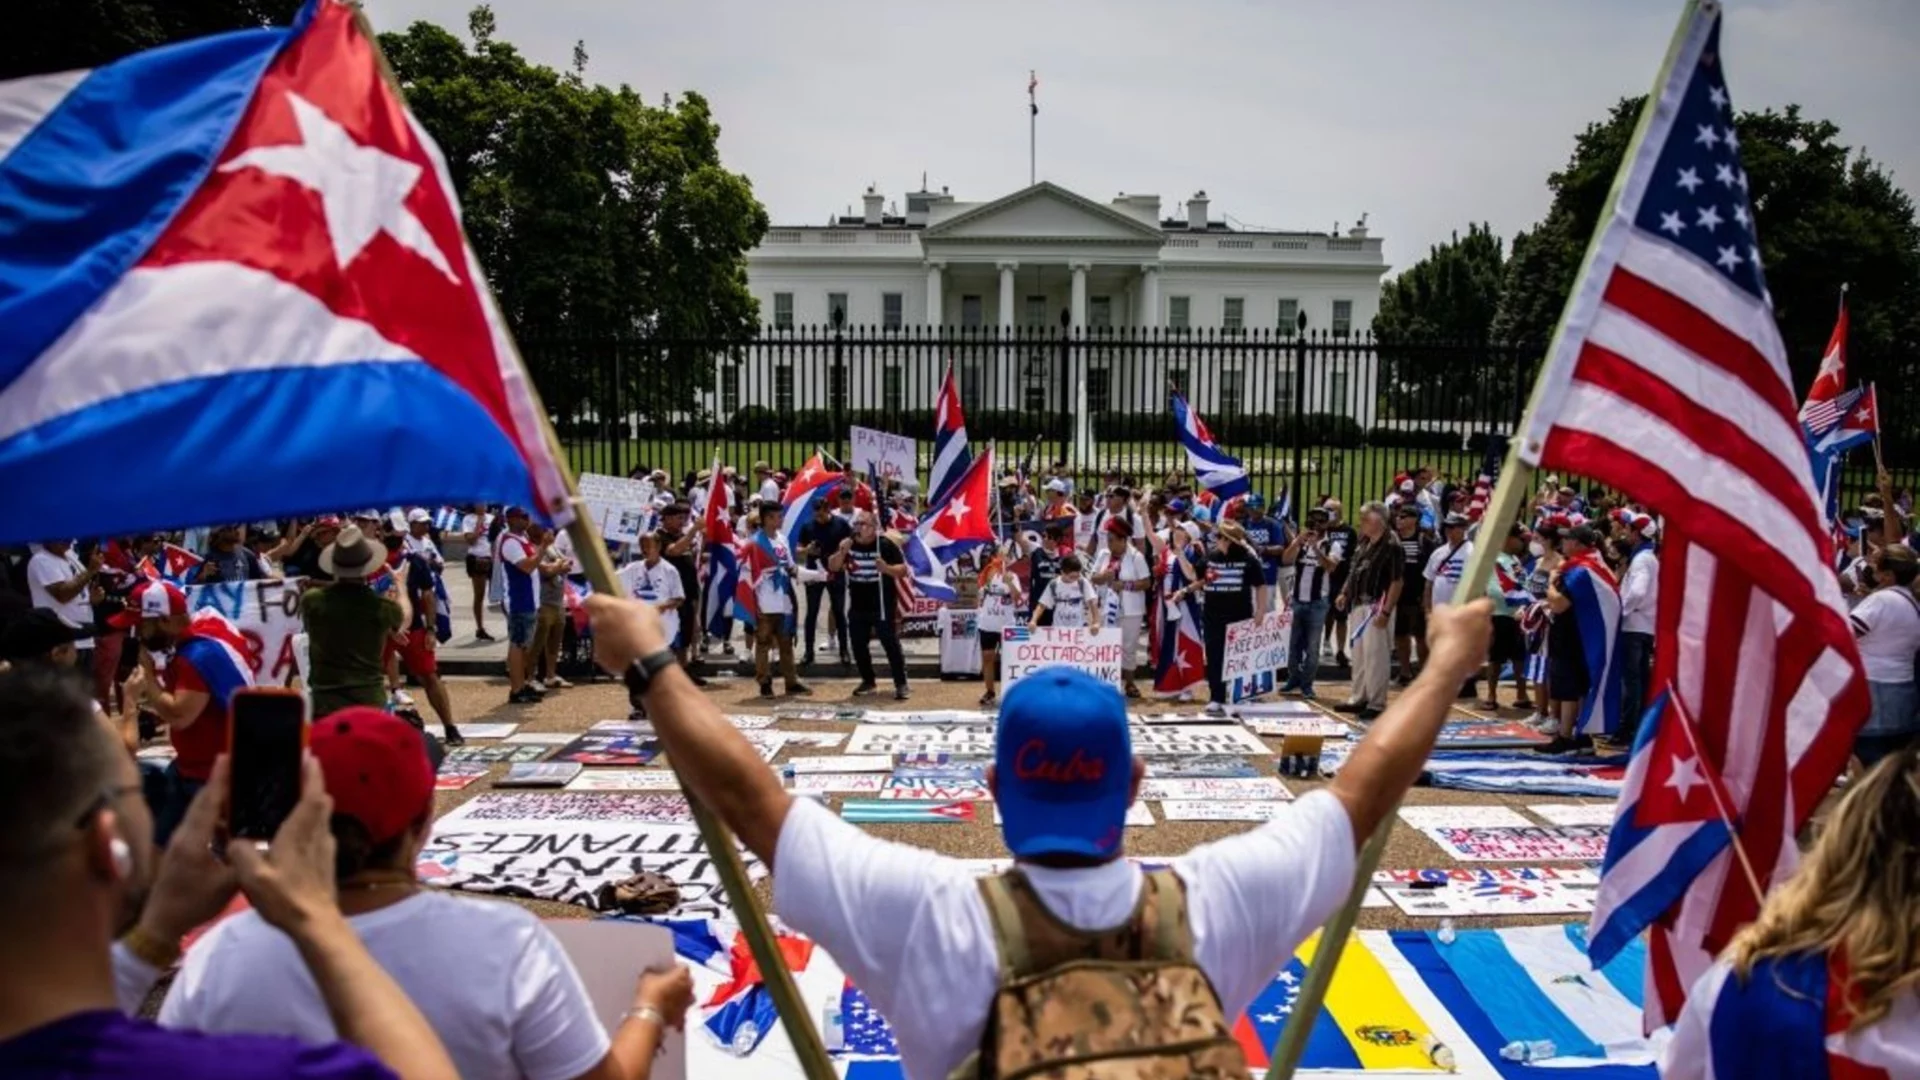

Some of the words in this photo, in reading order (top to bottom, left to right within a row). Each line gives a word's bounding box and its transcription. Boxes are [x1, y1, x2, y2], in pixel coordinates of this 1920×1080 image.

[857, 430, 908, 455] PATRIA
[256, 580, 303, 622] FO
[1043, 628, 1084, 645] THE
[1227, 631, 1282, 656] FREEDOM
[1226, 656, 1249, 676] FOR
[1256, 645, 1287, 669] CUBA
[1015, 738, 1104, 783] Cuba
